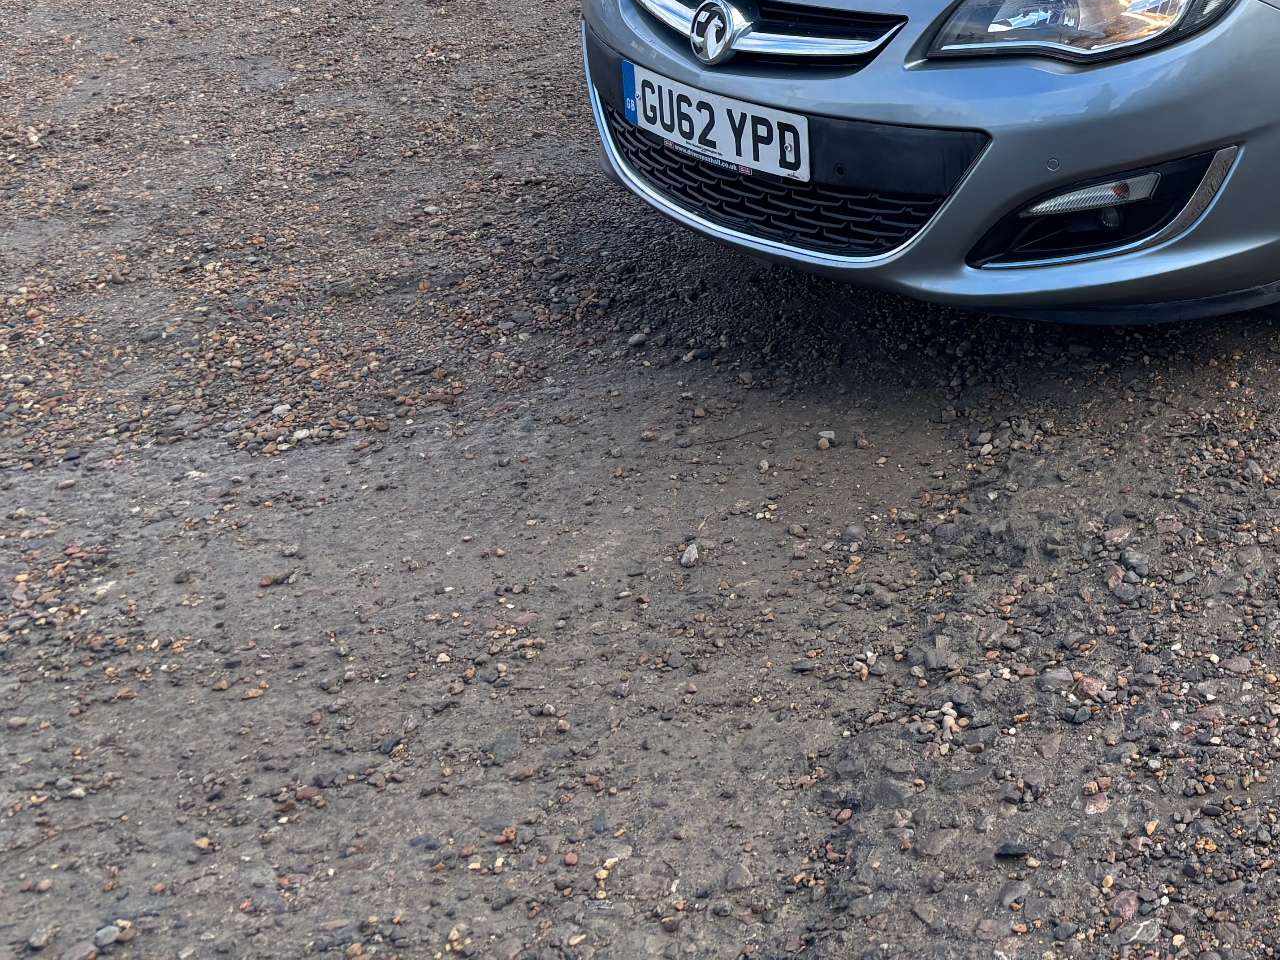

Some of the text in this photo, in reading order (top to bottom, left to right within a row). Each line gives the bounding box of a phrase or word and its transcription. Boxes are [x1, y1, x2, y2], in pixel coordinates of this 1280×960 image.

[626, 97, 636, 112] GB
[641, 79, 801, 171] GU62 YPD
